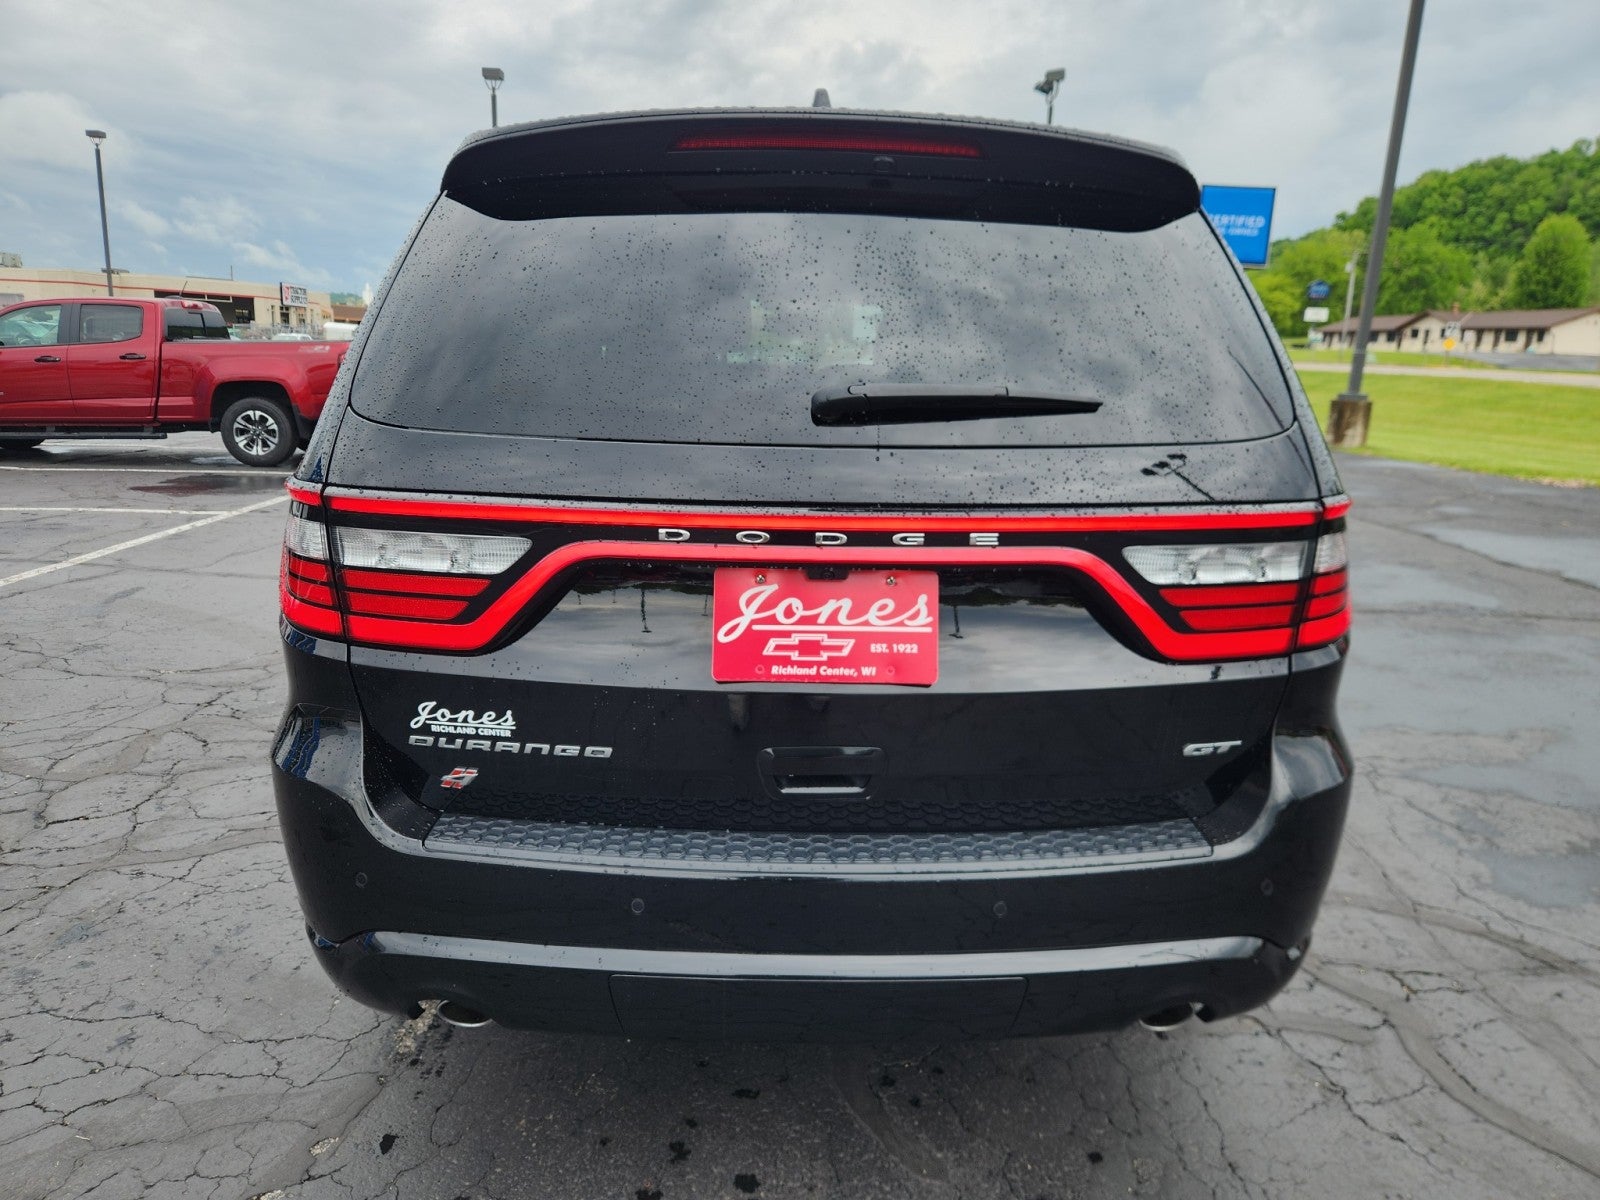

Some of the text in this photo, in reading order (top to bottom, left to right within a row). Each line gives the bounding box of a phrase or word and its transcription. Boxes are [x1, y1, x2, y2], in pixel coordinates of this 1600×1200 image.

[658, 528, 1000, 546] DODGE
[716, 583, 934, 643] Jones
[870, 644, 918, 654] EST. 1922
[771, 665, 876, 677] Richland Center, WI
[410, 701, 516, 729] Jones
[431, 725, 512, 737] RICHLAND CENTER
[408, 735, 613, 758] DURANGO
[1183, 740, 1242, 757] GT
